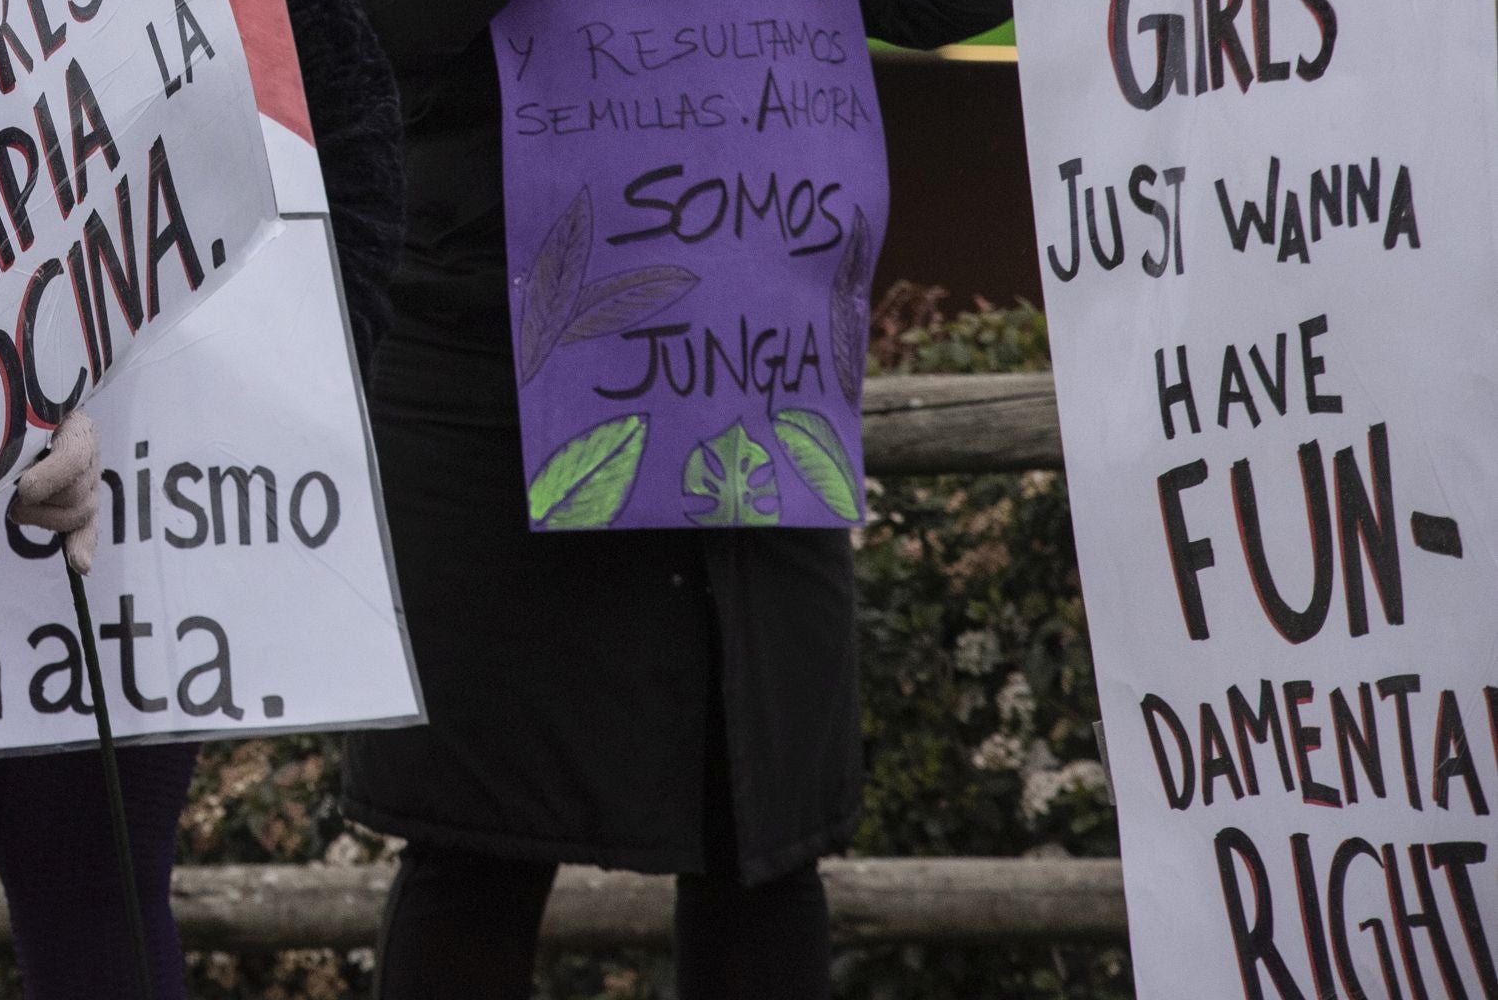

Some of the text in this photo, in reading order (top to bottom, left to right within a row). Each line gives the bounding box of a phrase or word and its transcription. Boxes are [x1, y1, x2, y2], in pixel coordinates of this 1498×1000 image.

[577, 19, 847, 79] RESULTAMOS
[757, 67, 870, 132] AHORA
[606, 164, 844, 257] SOMOS
[1047, 155, 1422, 282] JUST WANNA
[593, 314, 825, 420] JUNGLA
[1155, 313, 1344, 440] HAVE
[1157, 421, 1464, 646] FUN-
